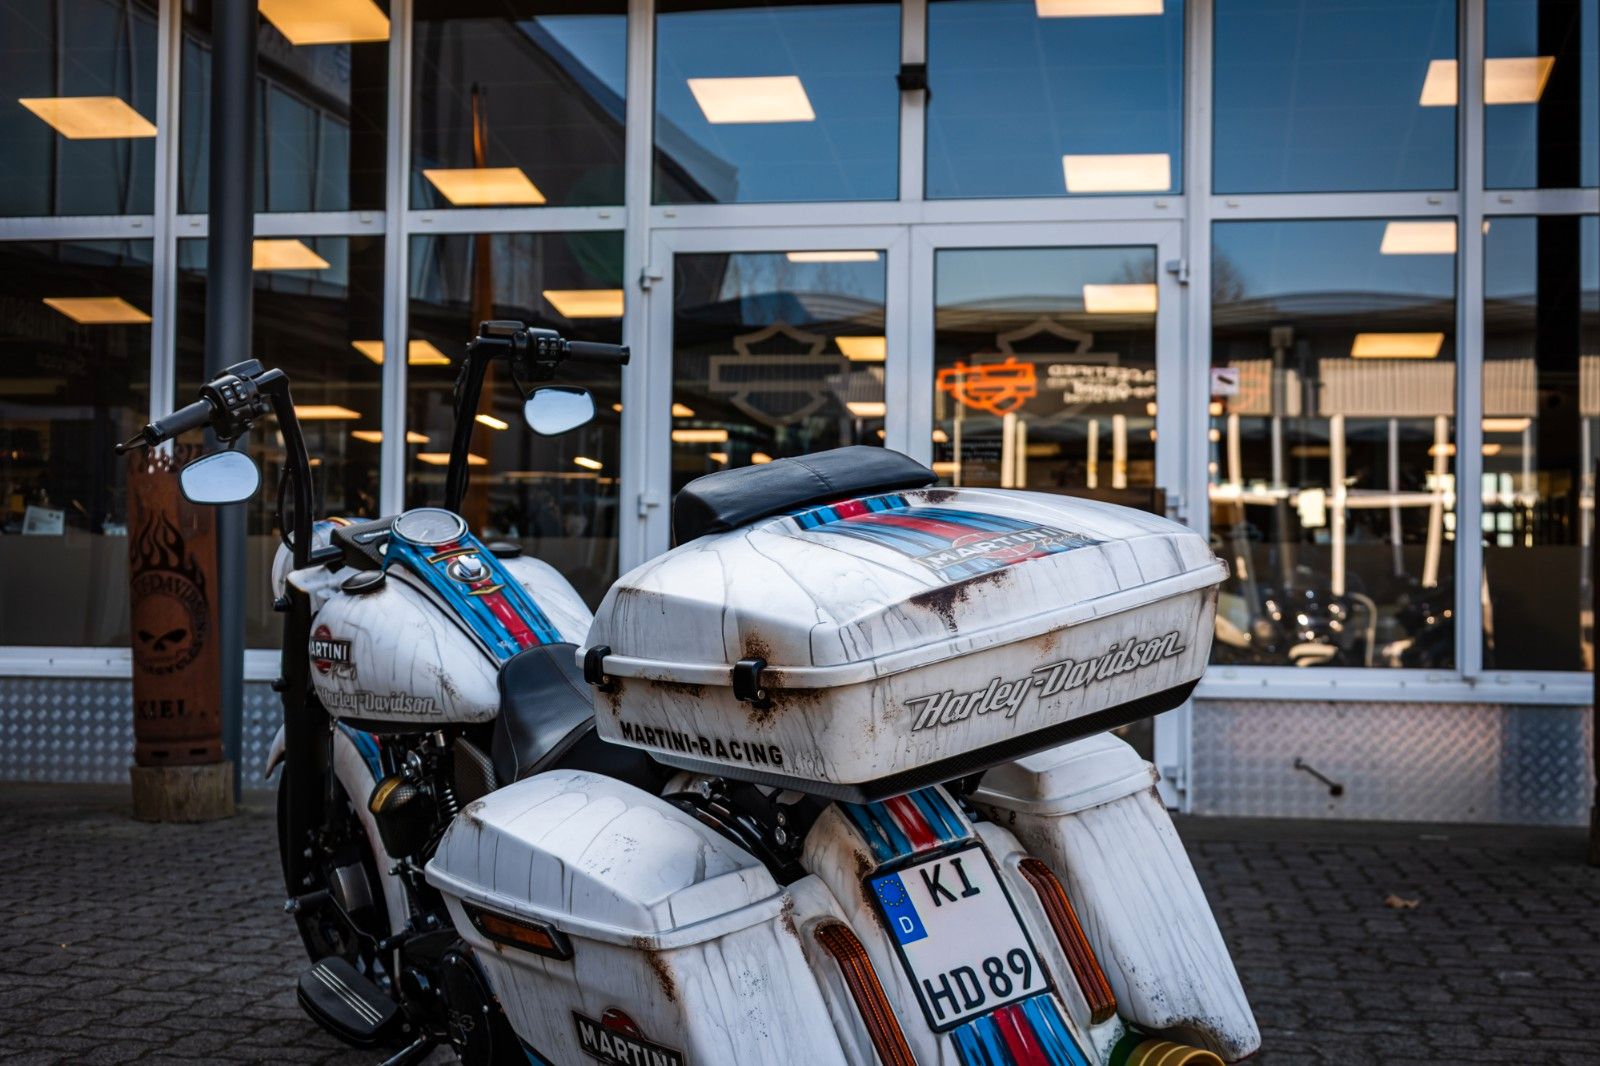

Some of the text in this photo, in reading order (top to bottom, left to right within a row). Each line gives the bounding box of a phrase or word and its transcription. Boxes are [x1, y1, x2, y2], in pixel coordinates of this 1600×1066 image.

[929, 527, 1060, 570] MARTINI
[310, 641, 347, 660] ARTINI
[904, 630, 1186, 732] Harley-Davidson
[620, 721, 783, 765] MARTINI-RACING
[919, 857, 981, 907] KI
[898, 915, 914, 934] D
